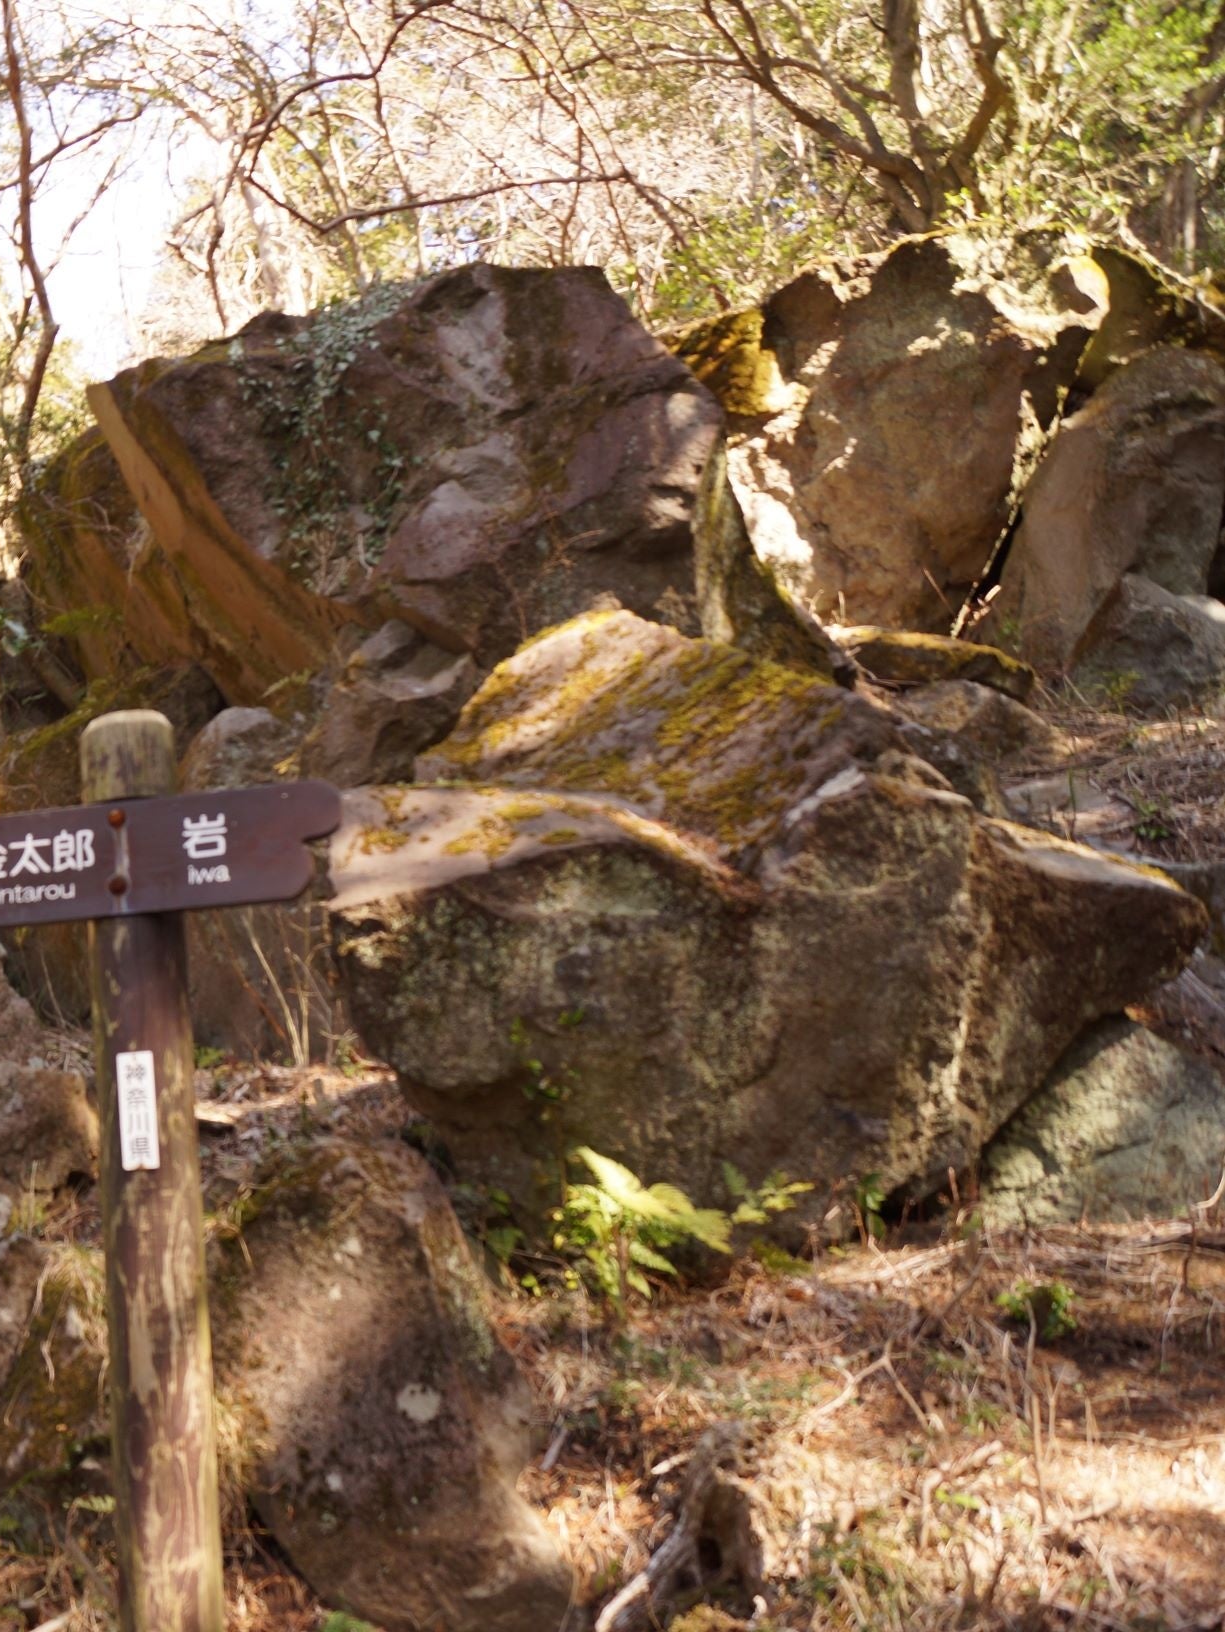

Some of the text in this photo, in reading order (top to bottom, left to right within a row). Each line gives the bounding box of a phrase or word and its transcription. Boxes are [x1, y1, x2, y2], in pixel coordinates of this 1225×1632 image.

[182, 813, 228, 859] 岩
[125, 1063, 151, 1160] 神奈川県
